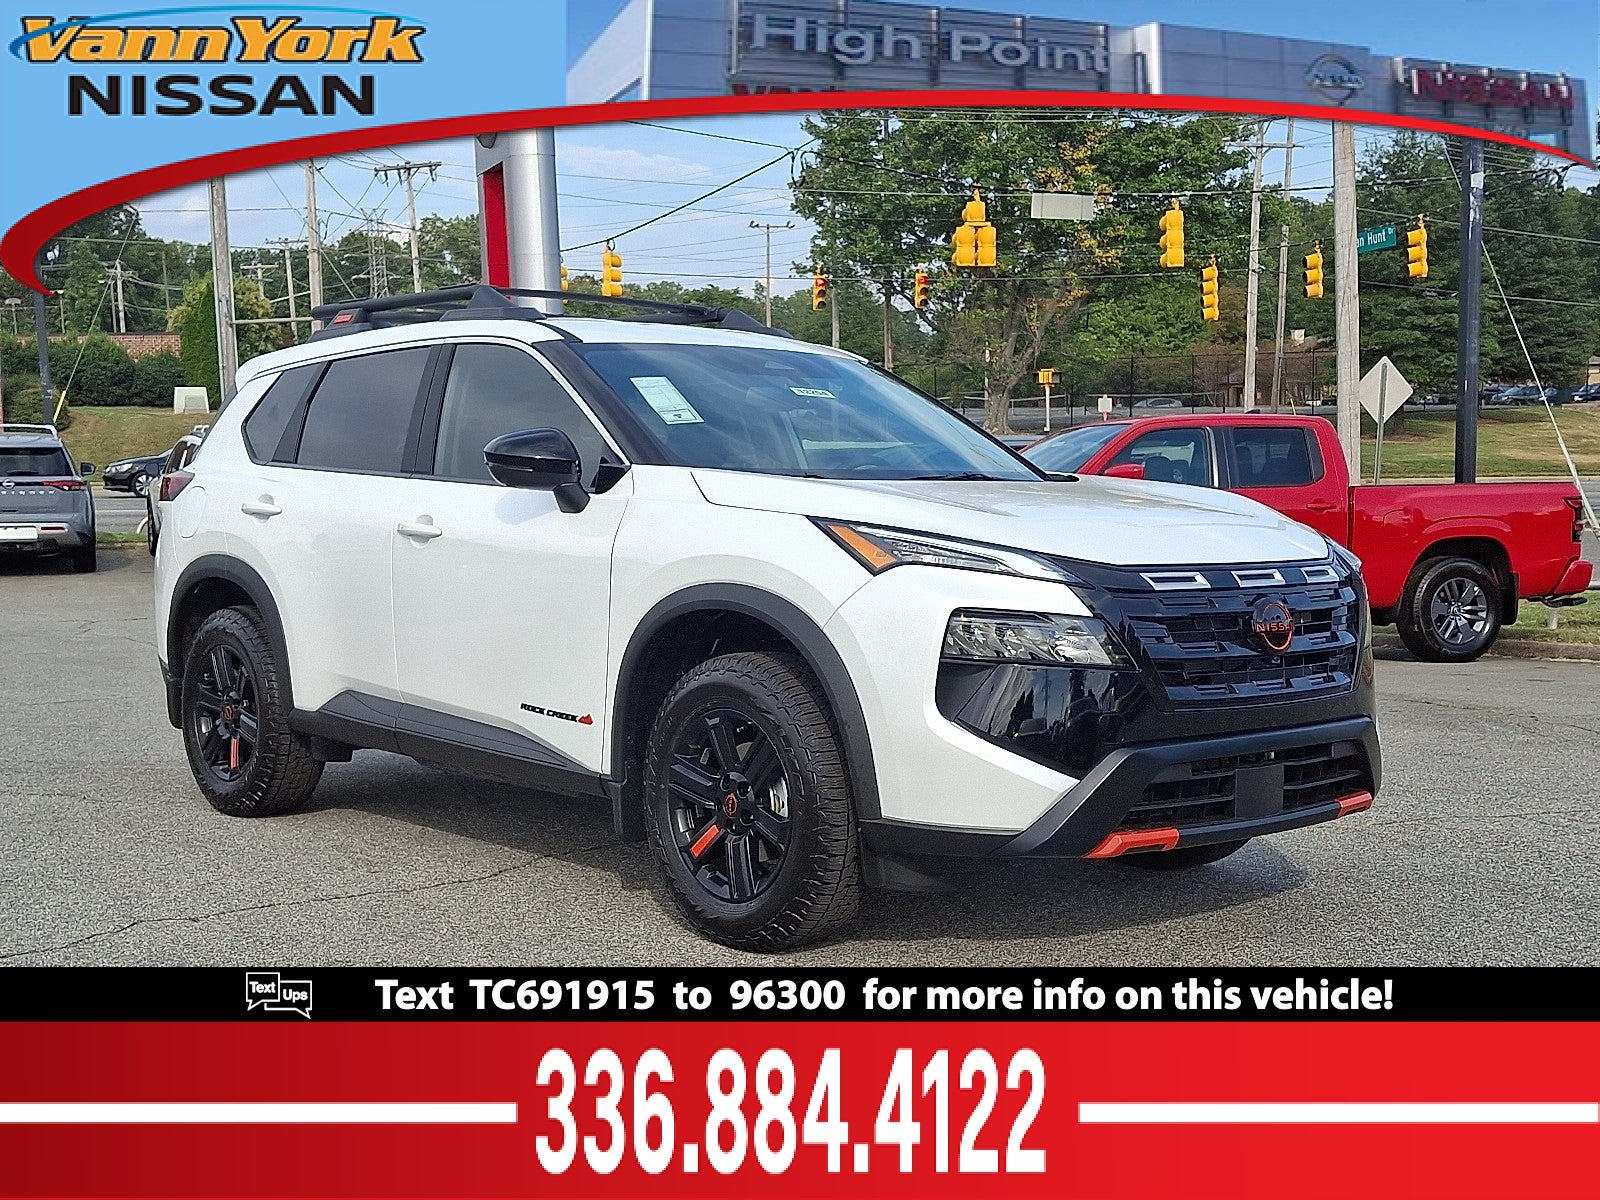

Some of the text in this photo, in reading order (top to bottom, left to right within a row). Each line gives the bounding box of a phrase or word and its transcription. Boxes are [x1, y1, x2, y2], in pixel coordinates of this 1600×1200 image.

[751, 13, 1110, 73] High Point
[1367, 229, 1386, 245] Hunt
[520, 703, 579, 722] ROCK CREEK
